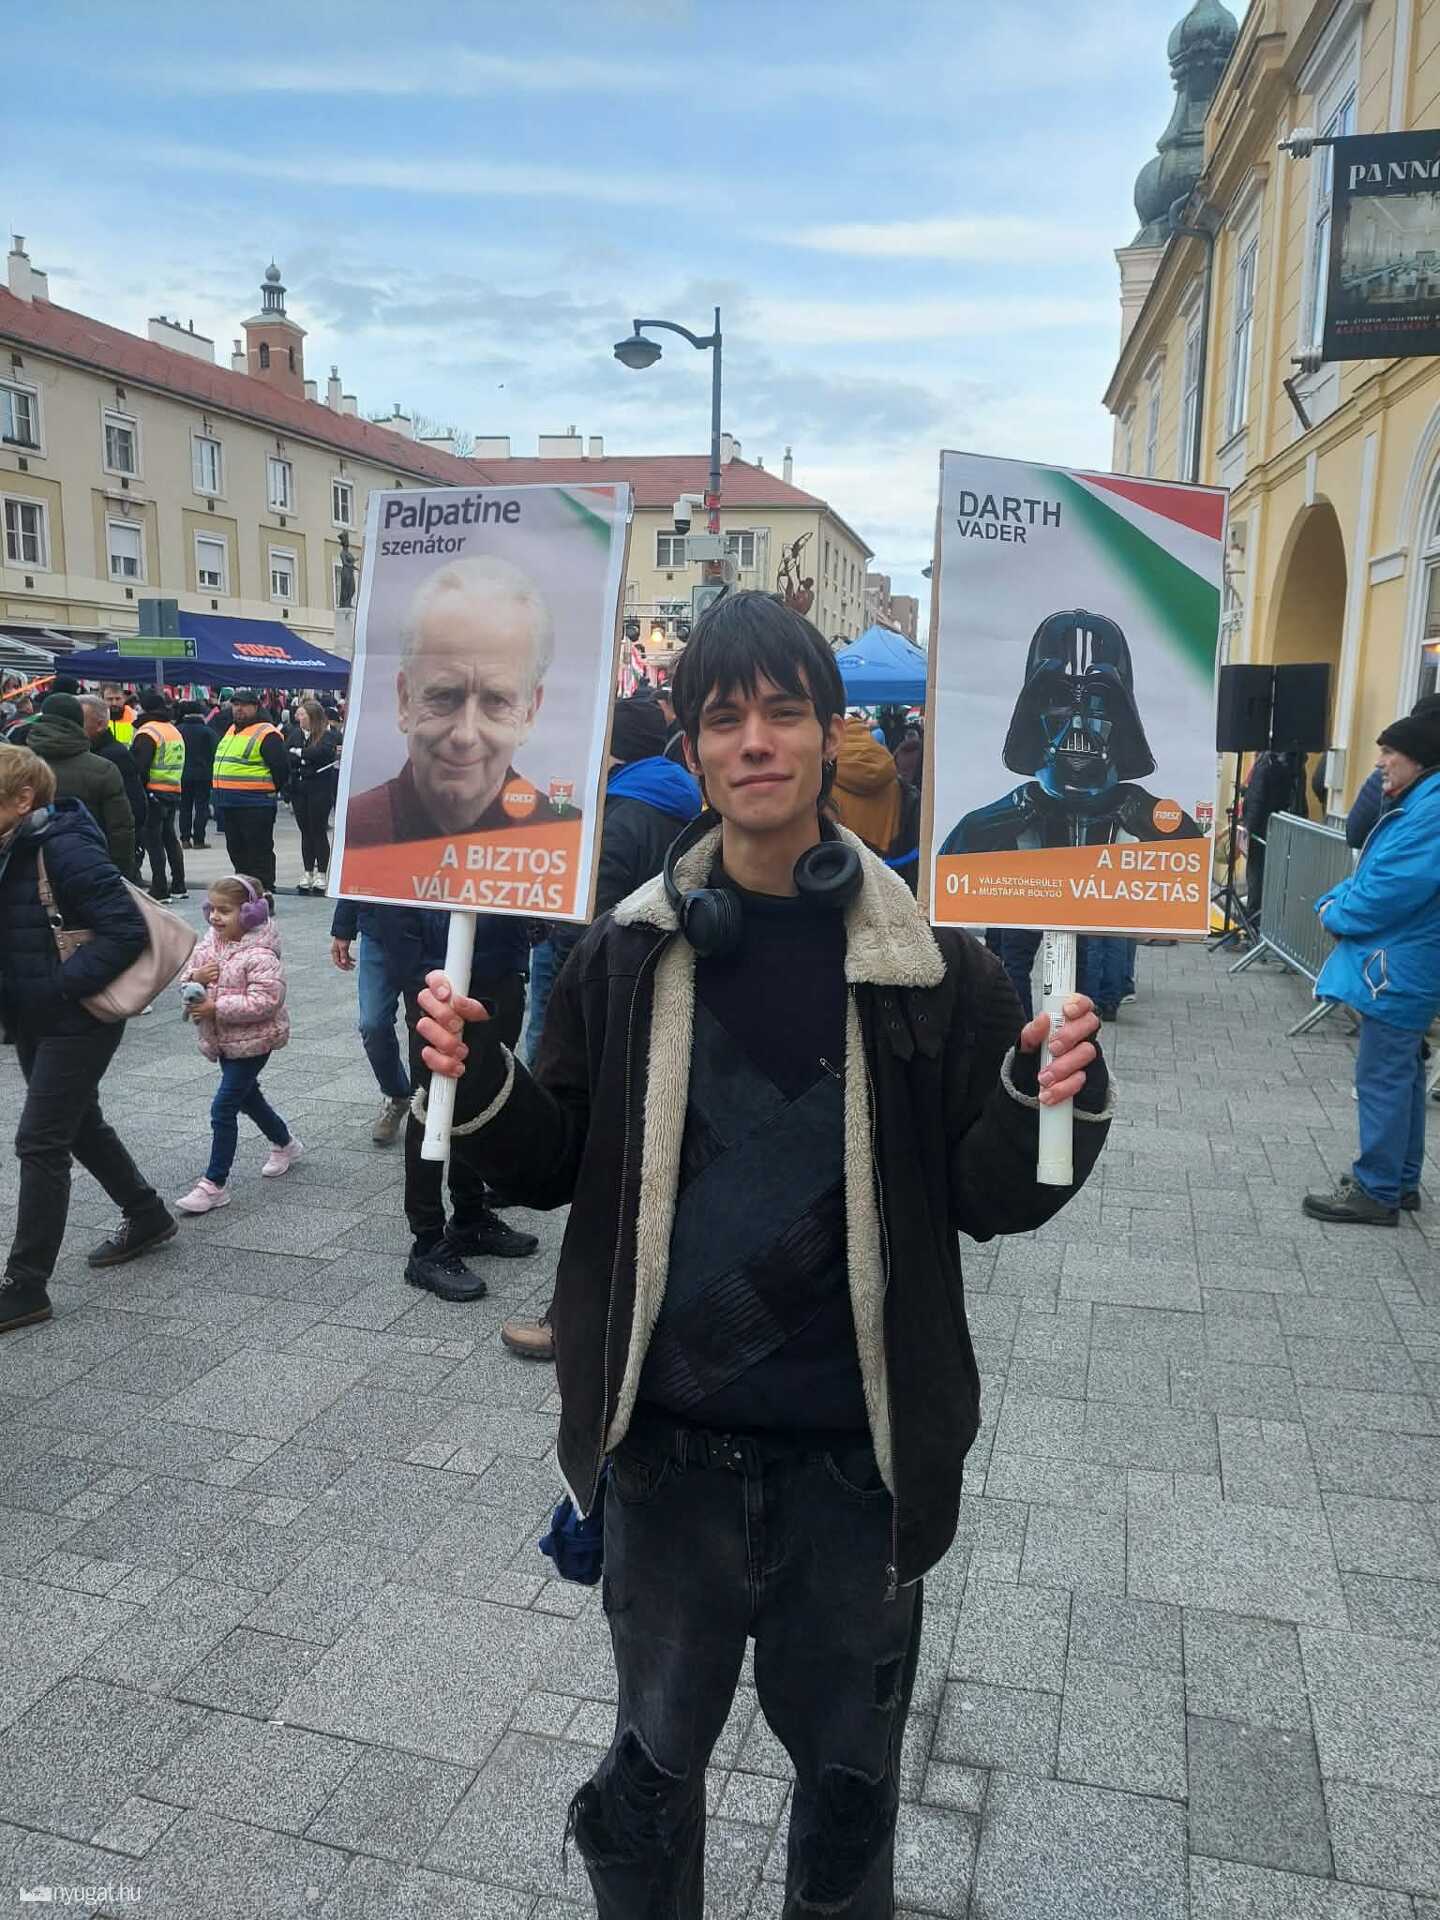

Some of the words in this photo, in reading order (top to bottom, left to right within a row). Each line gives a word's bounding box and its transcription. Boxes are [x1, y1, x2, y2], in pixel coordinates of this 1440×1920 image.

[384, 494, 521, 534] Palpatine
[959, 490, 1061, 528] DARTH
[381, 534, 466, 556] szenátor
[957, 519, 1026, 544] VADER
[440, 844, 459, 870] A
[466, 845, 567, 875] BIZTOS
[1097, 848, 1113, 869] A
[1121, 850, 1201, 873] BIZTOS
[412, 870, 563, 909] VÁLASZTÁS
[946, 873, 977, 895] 01.
[1069, 874, 1200, 902] VÁLASZTÁS
